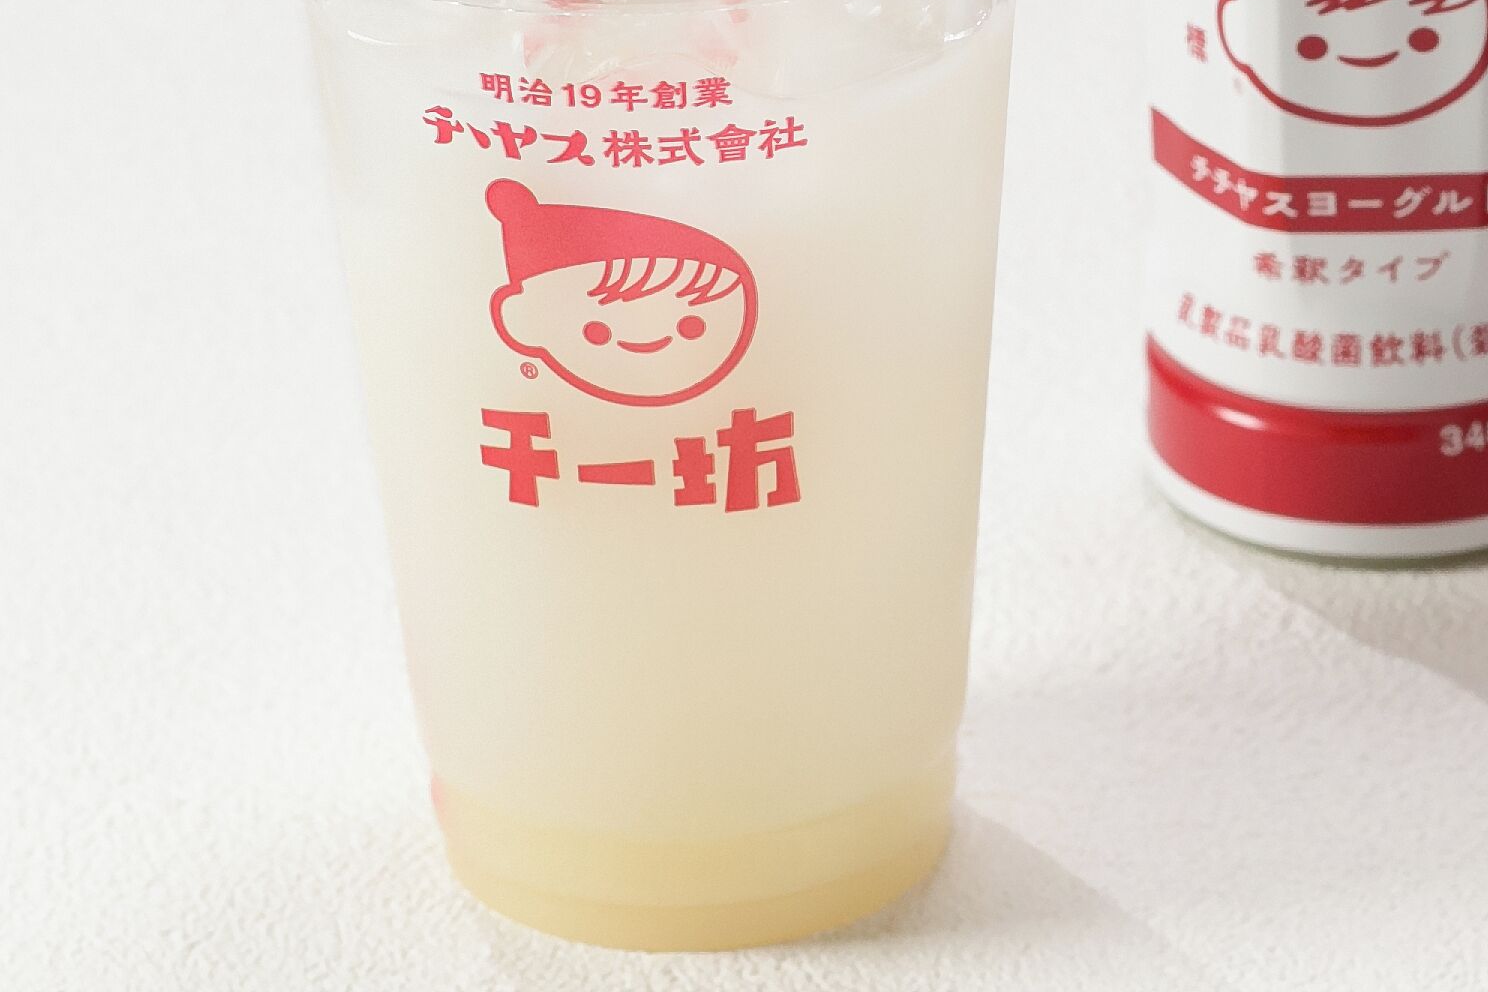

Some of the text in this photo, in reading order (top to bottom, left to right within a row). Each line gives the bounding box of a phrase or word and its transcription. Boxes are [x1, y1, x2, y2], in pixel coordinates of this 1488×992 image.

[480, 72, 734, 112] 明治19年創業
[480, 407, 801, 513] チー坊
